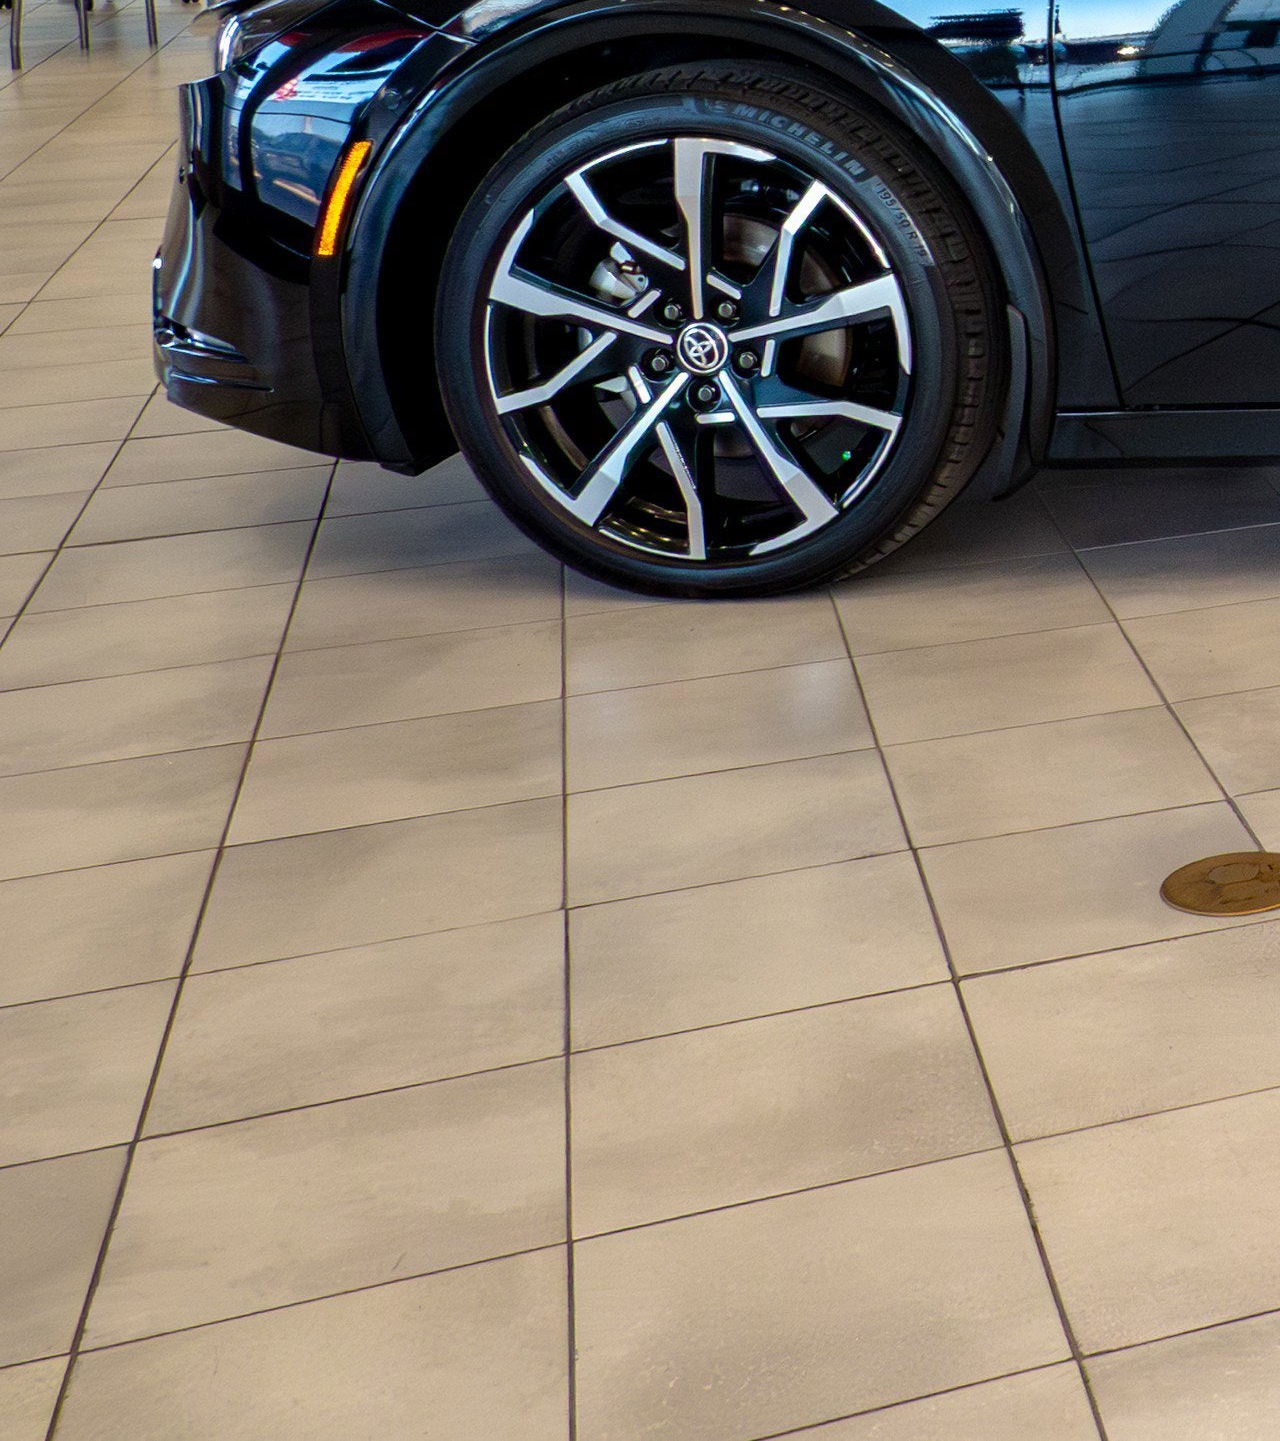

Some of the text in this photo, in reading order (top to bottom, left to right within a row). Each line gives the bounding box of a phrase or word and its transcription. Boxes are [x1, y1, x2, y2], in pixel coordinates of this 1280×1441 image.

[734, 105, 866, 176] MICHELIN
[876, 187, 911, 230] 195/50
[907, 231, 917, 240] R
